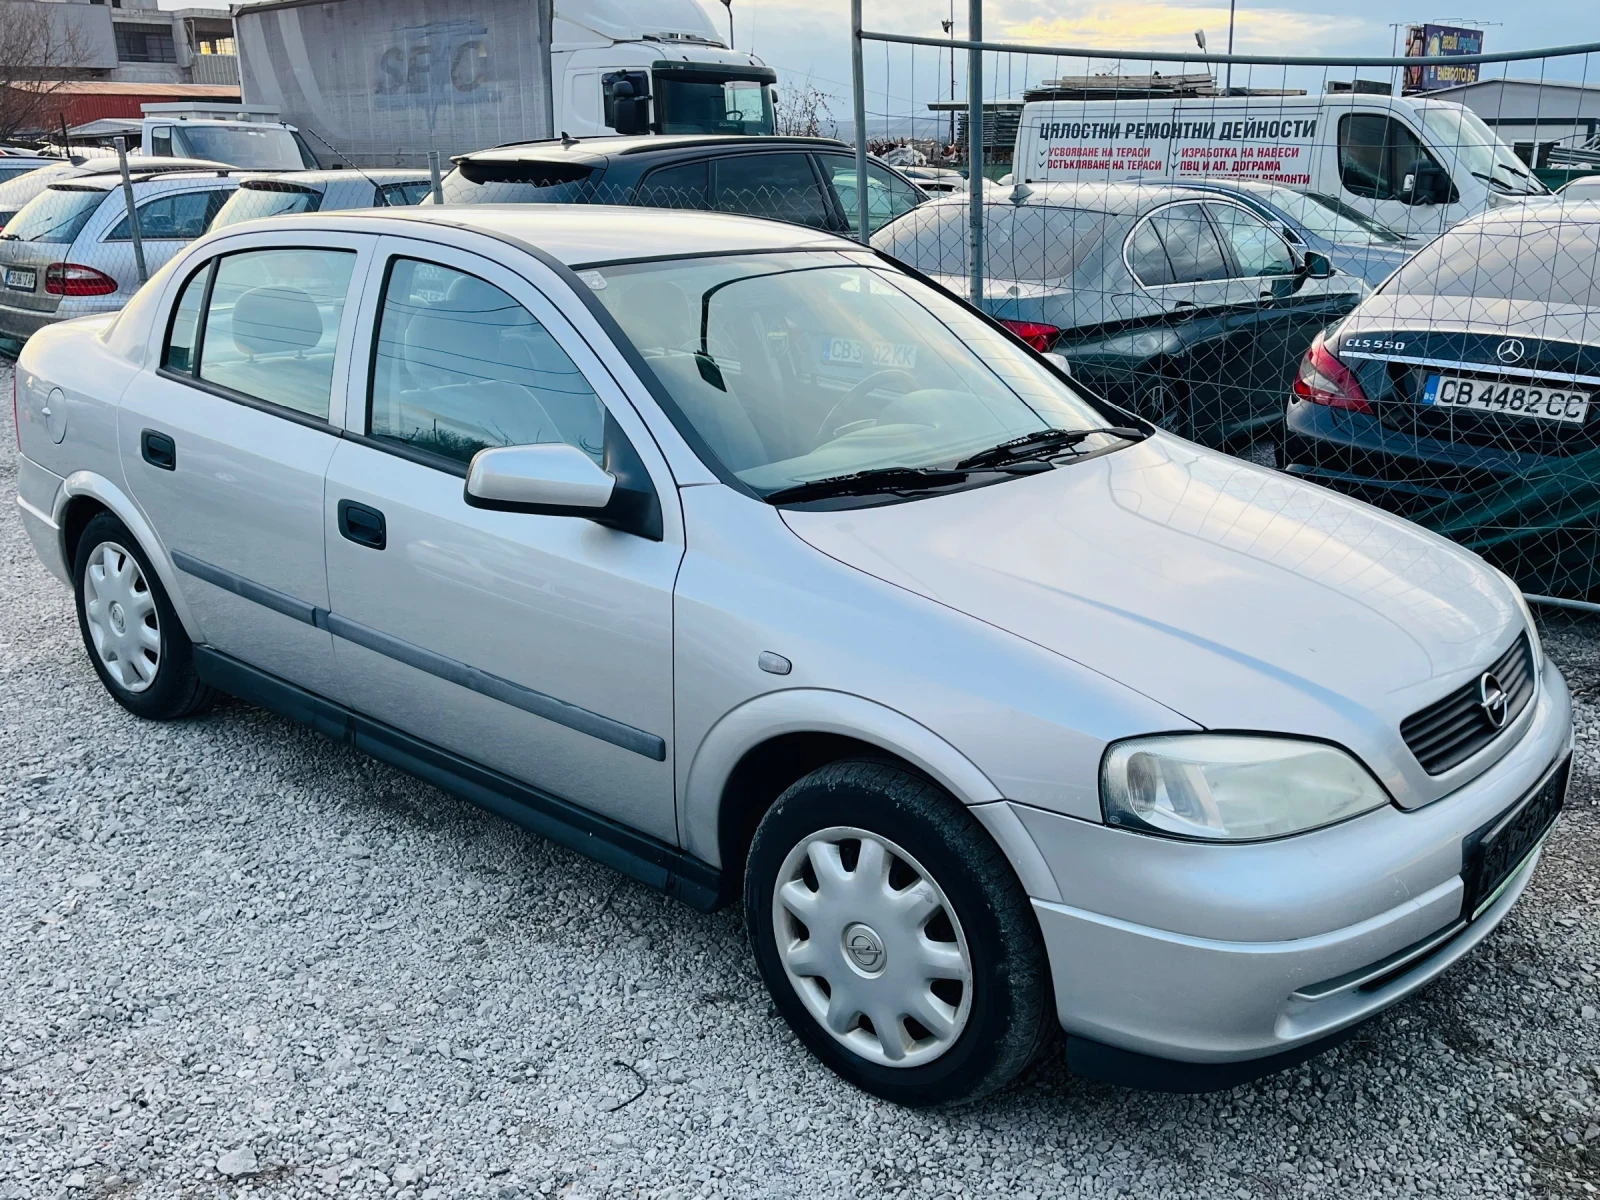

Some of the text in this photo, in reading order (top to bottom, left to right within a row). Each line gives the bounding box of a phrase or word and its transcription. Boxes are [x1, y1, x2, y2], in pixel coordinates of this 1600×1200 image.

[1039, 117, 1317, 140] ЦЯЛОСТНИ РЕМОНТНИ ДЕЙНОСТИ
[1048, 147, 1151, 157] УСВОЯВАНЕ НА ТЕРАСИ
[1181, 147, 1300, 158] ИЗРАБОТКА НА НАВЕСИ
[1047, 159, 1162, 170] ОСТЪКЛЯВАНЕ НА ТЕРАСИ
[1180, 160, 1281, 172] ПВЦ И АЛ. ДОГРАМА
[1345, 338, 1406, 350] CLS 550
[1439, 380, 1474, 405] CB
